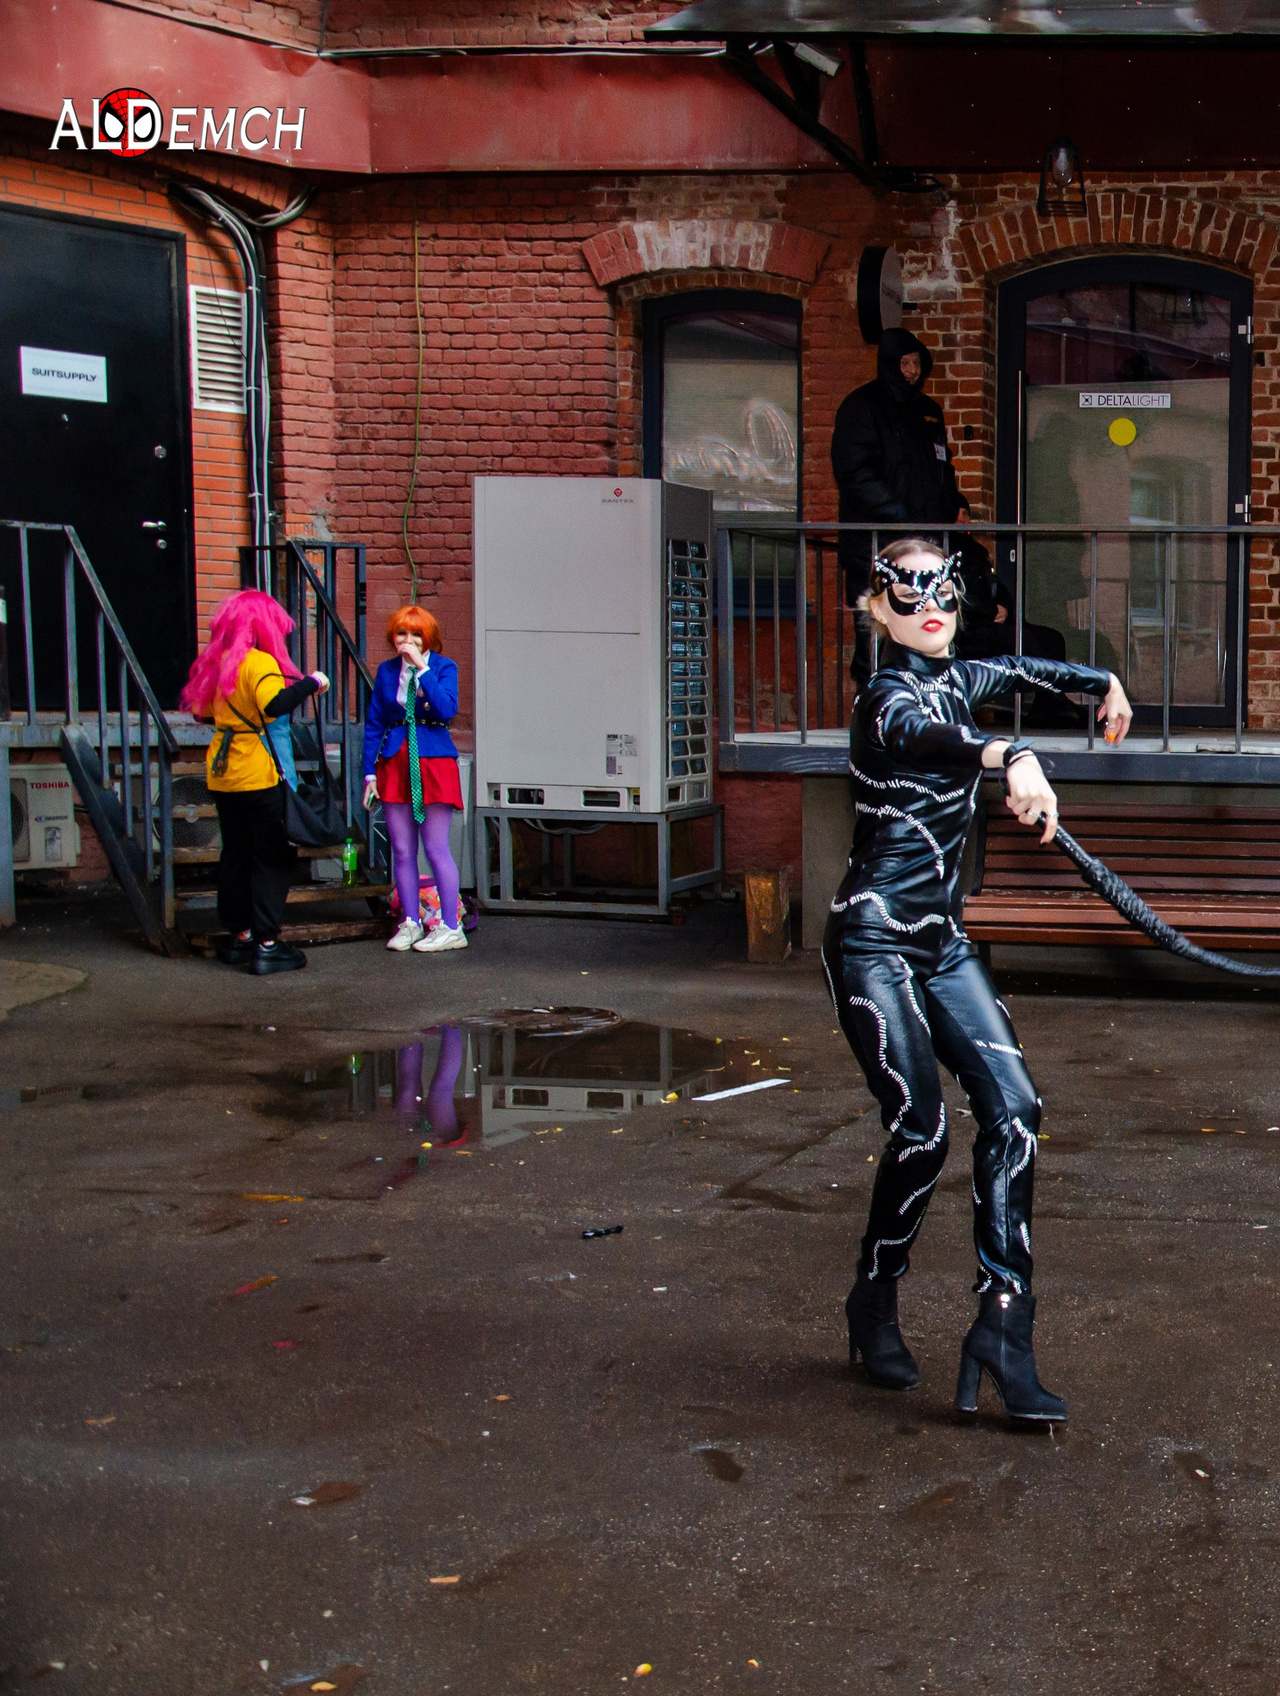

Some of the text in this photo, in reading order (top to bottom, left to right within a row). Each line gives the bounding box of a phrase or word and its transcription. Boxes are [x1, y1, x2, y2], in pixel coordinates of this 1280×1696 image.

[31, 367, 98, 382] SUITSUPPLY
[1097, 394, 1166, 407] DELTALIGHT
[30, 781, 70, 790] TOSHIBA
